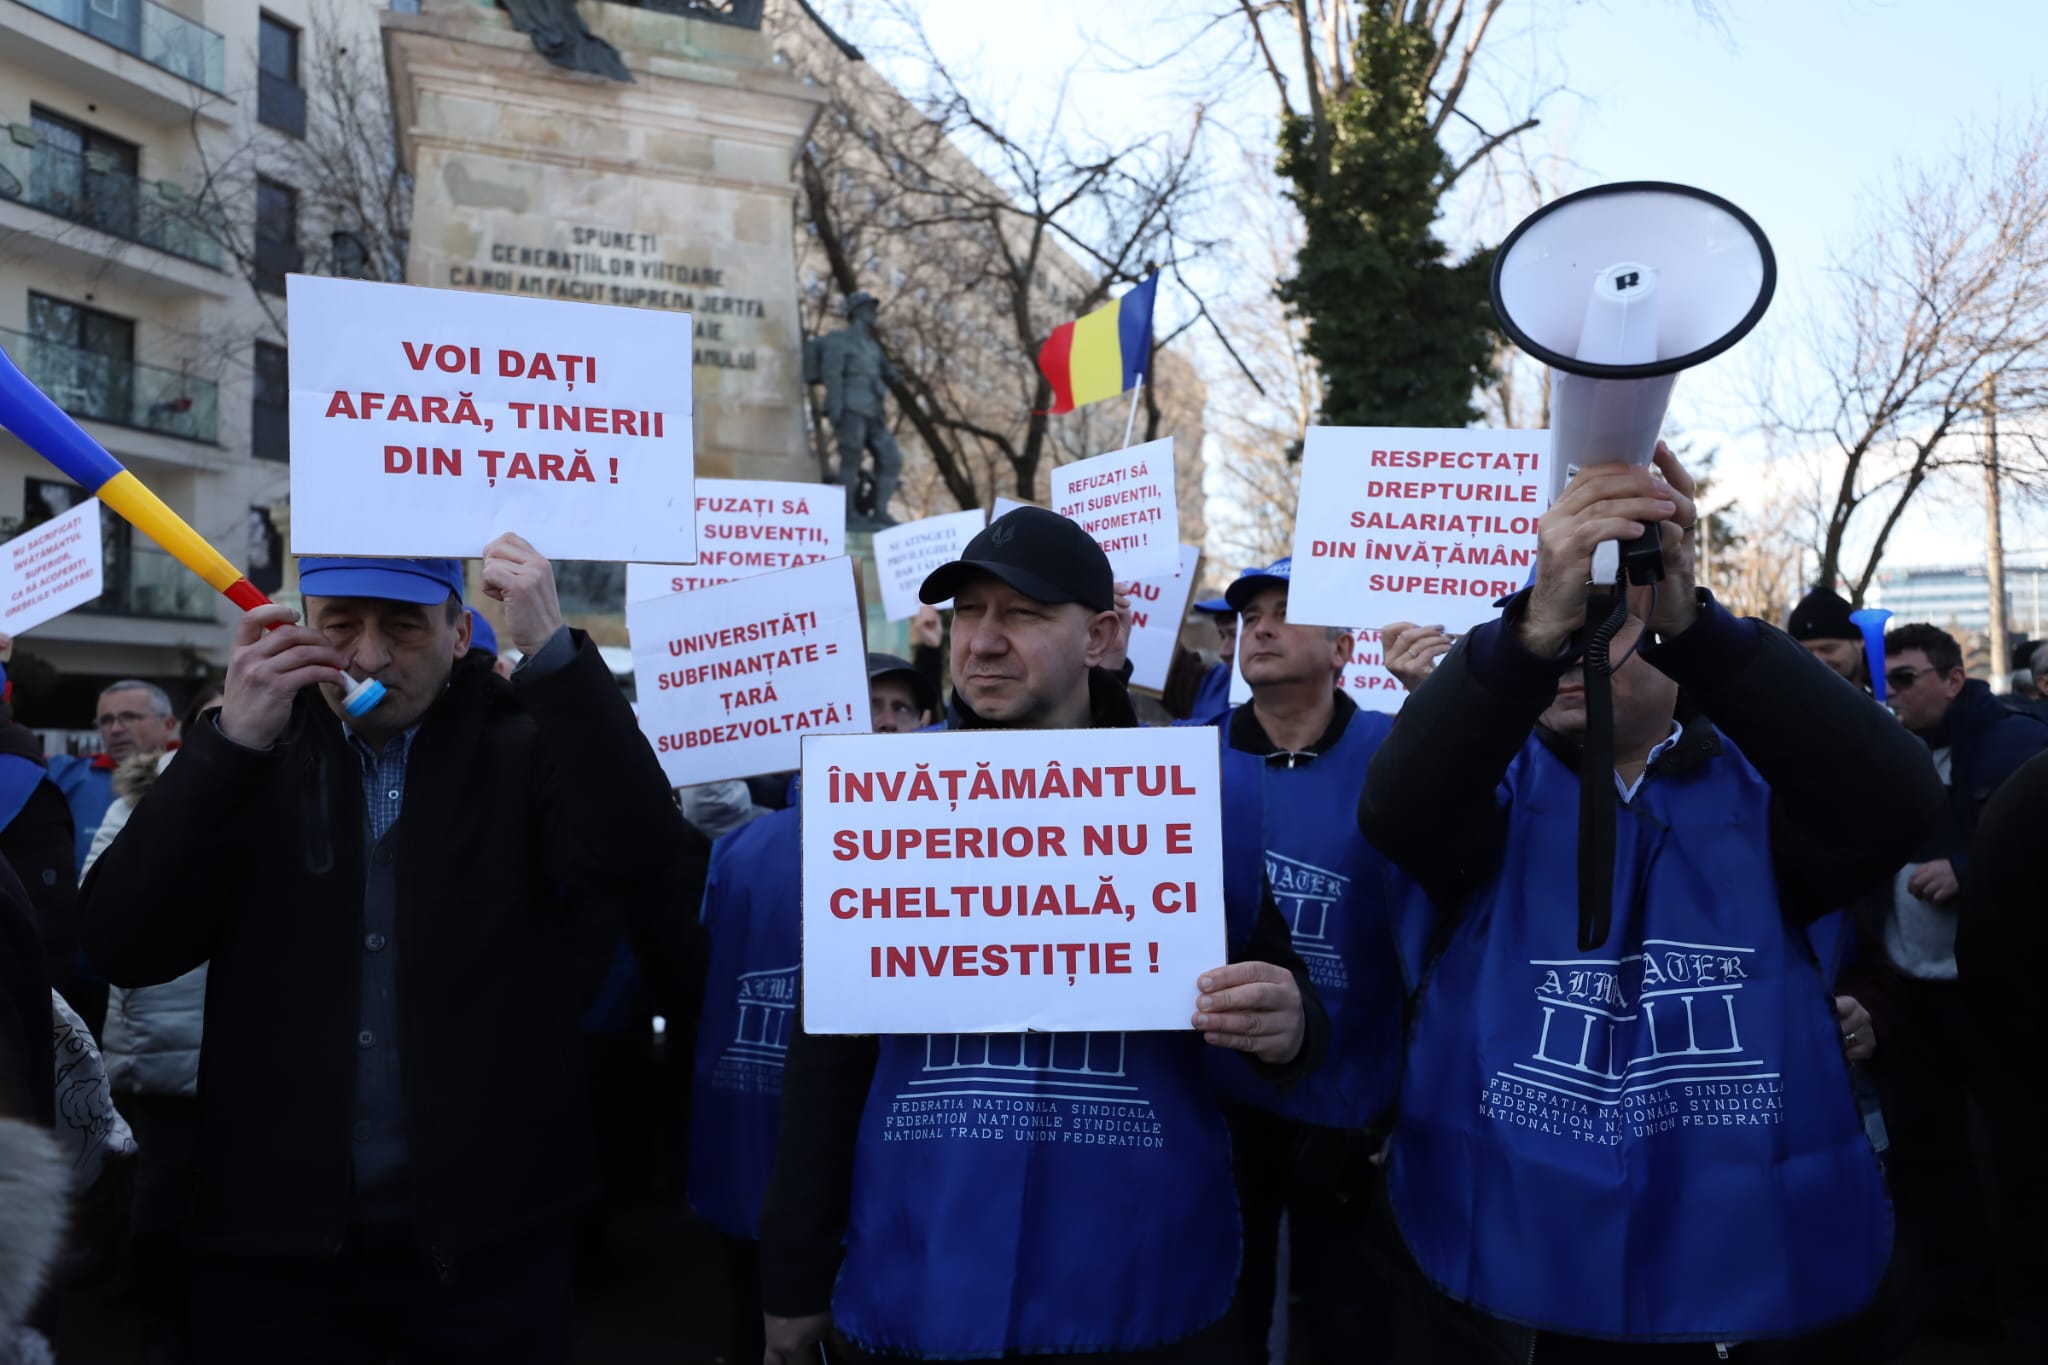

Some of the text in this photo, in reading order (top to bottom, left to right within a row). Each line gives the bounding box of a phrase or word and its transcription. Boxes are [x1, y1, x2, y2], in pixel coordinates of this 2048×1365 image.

[403, 341, 596, 389] VOI DAȚI
[324, 390, 663, 438] AFARĂ, TINERII
[384, 445, 618, 486] DIN ȚARĂ !
[1371, 450, 1539, 476] RESPECTAȚI
[1068, 469, 1126, 494] REFUZAȚI
[1088, 484, 1161, 511] SUBVENȚII,
[1367, 481, 1536, 503] DREPTURILE
[696, 497, 810, 518] FUZAȚI SĂ
[704, 524, 829, 546] SUBVENȚII,
[1098, 535, 1139, 553] ENȚII
[1312, 539, 1538, 569] DIN ÎNVĂȚĂMÂN
[668, 611, 817, 657] UNIVERSITĂȚI
[658, 644, 819, 690] SUBFINANȚATE
[720, 681, 778, 715] ȚARĂ
[658, 702, 853, 753] SUBDEZVOLTATĂ !
[829, 760, 1196, 809] ÎNVĂȚĂMÂNTUL
[833, 823, 1193, 861] SUPERIOR NU E
[830, 876, 1196, 921] CHELTUIALĂ, CI
[871, 942, 1159, 984] INVESTIȚIE !
[892, 1098, 1156, 1120] FEDERATIA NATIONALA SINDICALA
[1481, 1090, 1593, 1130] FEDERATION
[1690, 1096, 1783, 1112] SYNDICAL
[1490, 1078, 1588, 1114] FEDERATIA
[1599, 1089, 1671, 1119] NAONALA
[884, 1127, 1164, 1149] NATIONAL TRADE UNION FEDERATION
[886, 1112, 1162, 1134] FEDERATION NATIONALE SYNDICALE
[1479, 1105, 1562, 1135] NATIONAL
[1633, 1118, 1675, 1139] UNION
[1681, 1112, 1783, 1127] FEDERATI
